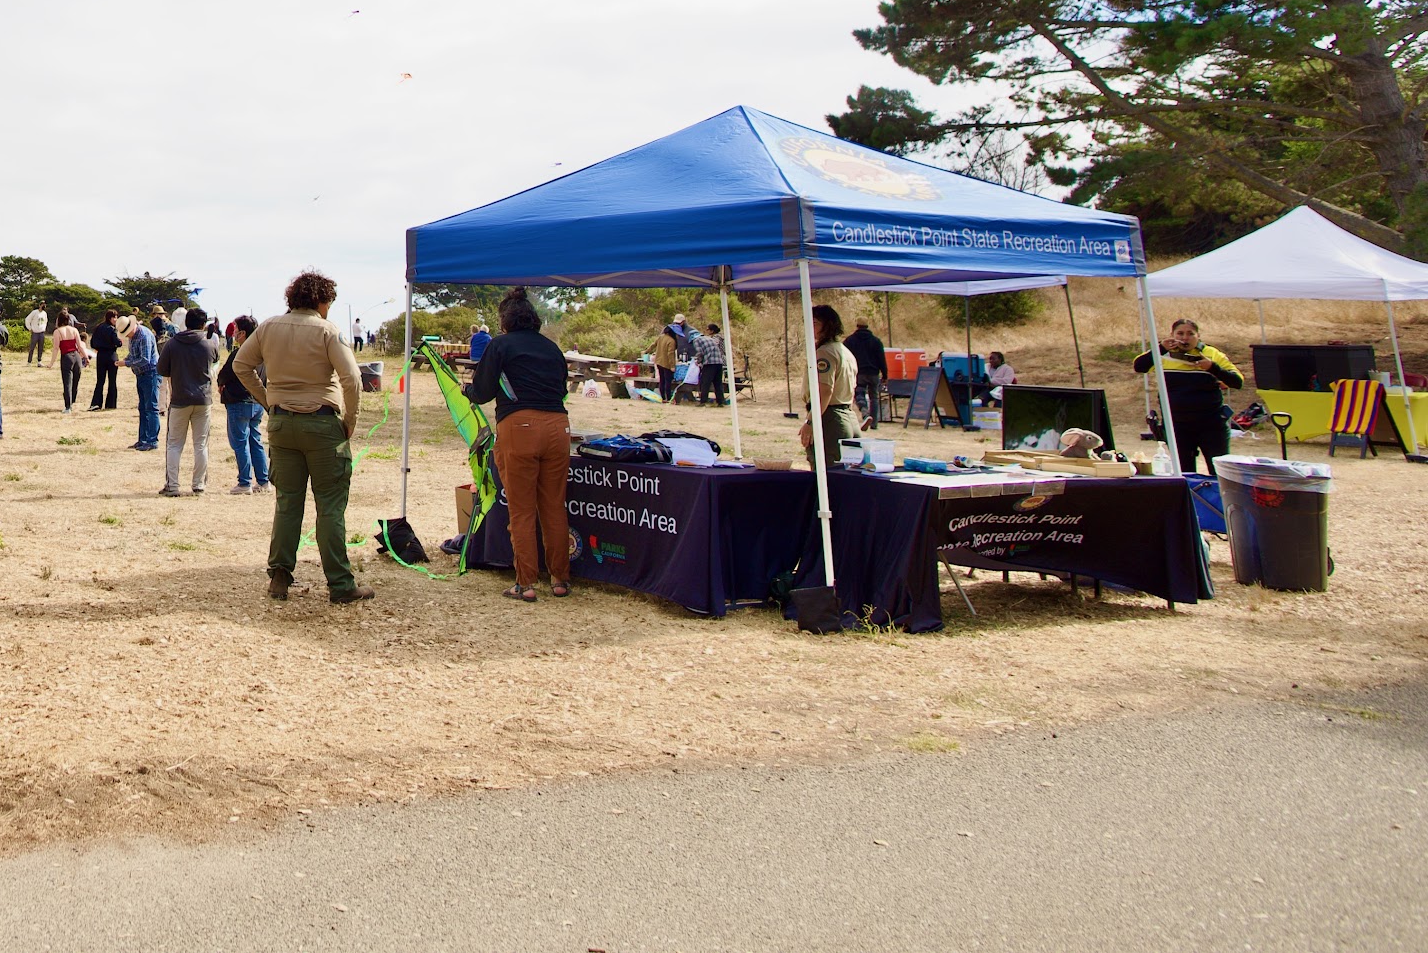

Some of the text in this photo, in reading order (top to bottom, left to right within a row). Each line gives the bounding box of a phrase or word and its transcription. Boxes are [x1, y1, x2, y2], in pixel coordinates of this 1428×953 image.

[832, 220, 1112, 256] Candlestick Point State Recreation Area
[617, 469, 661, 496] Point
[564, 498, 678, 535] creation Area
[948, 513, 1084, 532] Candlestick Point
[1043, 530, 1084, 544] Area
[601, 542, 626, 555] PARKS
[996, 547, 1006, 556] by
